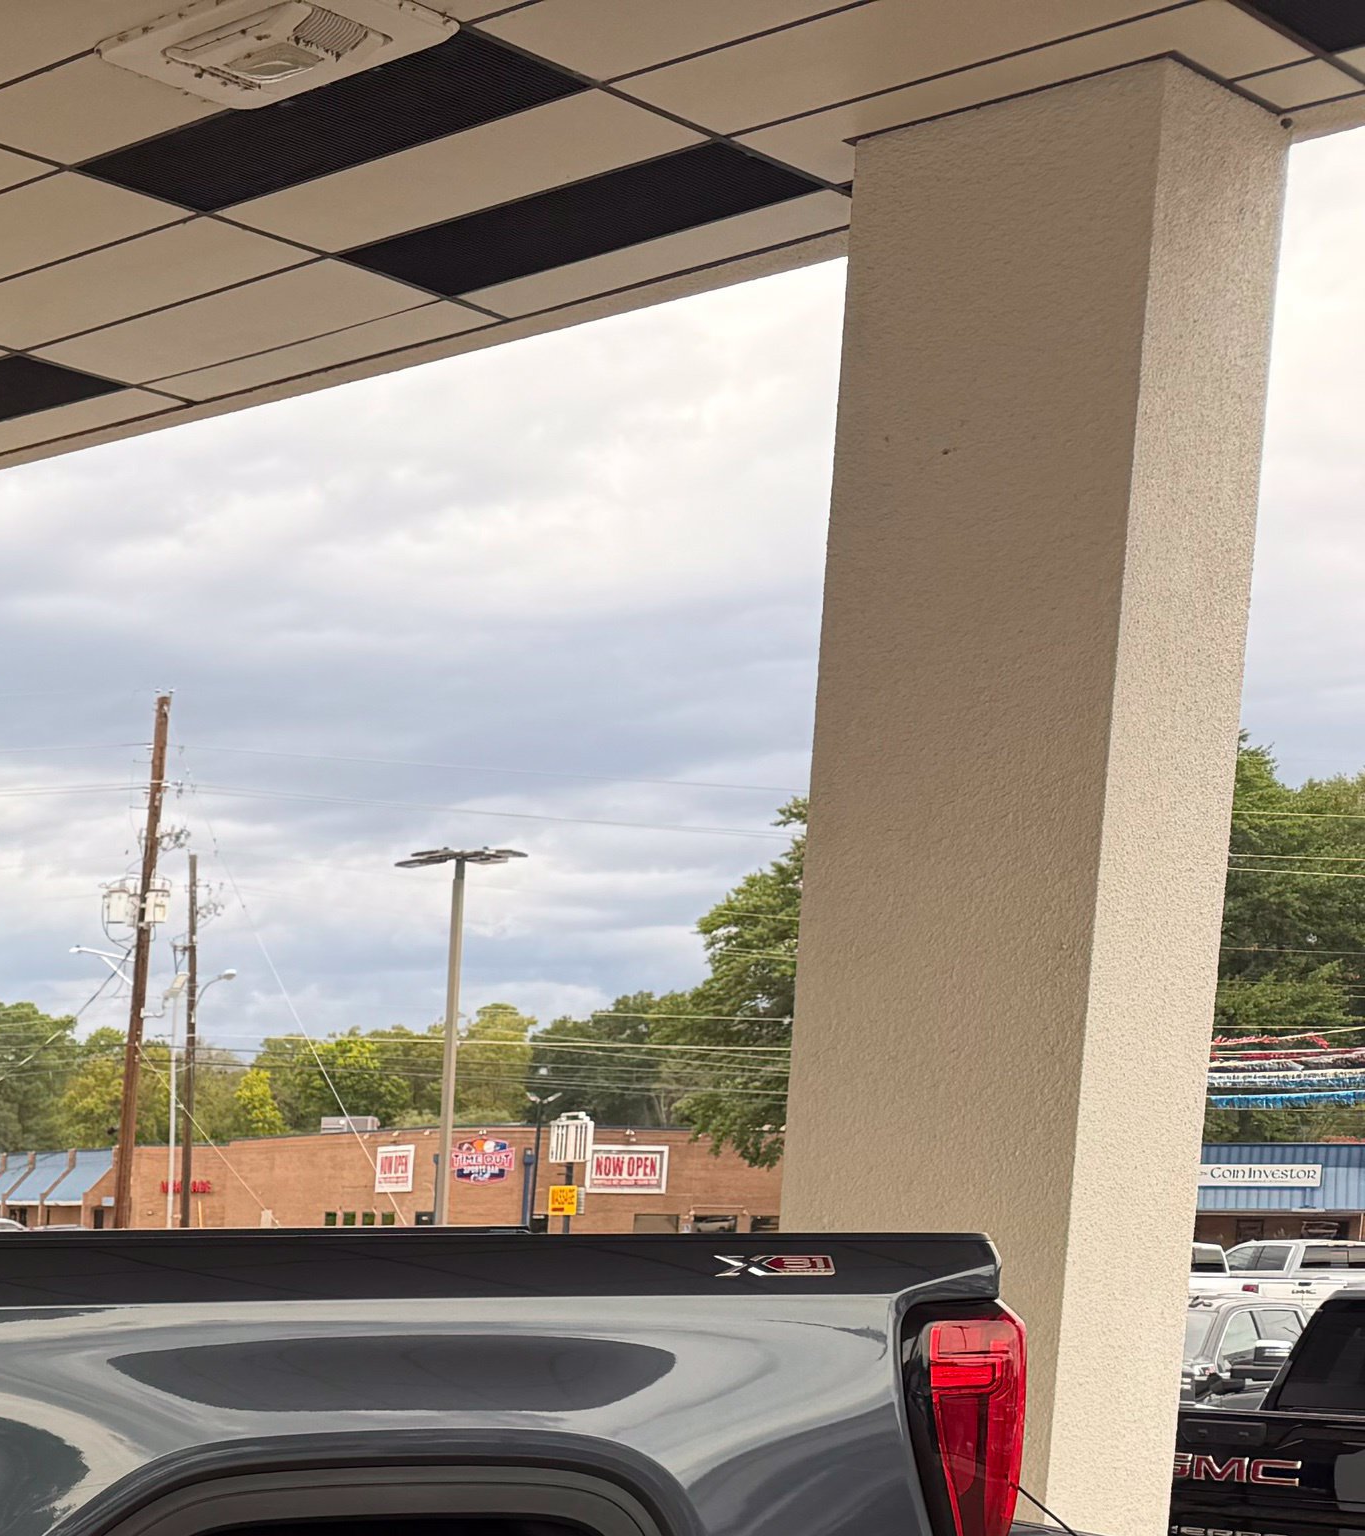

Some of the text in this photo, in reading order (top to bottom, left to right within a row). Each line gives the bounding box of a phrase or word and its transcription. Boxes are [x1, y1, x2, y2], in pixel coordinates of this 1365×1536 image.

[452, 1152, 513, 1167] TIME OUT
[595, 1156, 657, 1177] NOW OPEN
[1173, 1453, 1302, 1487] GMC
